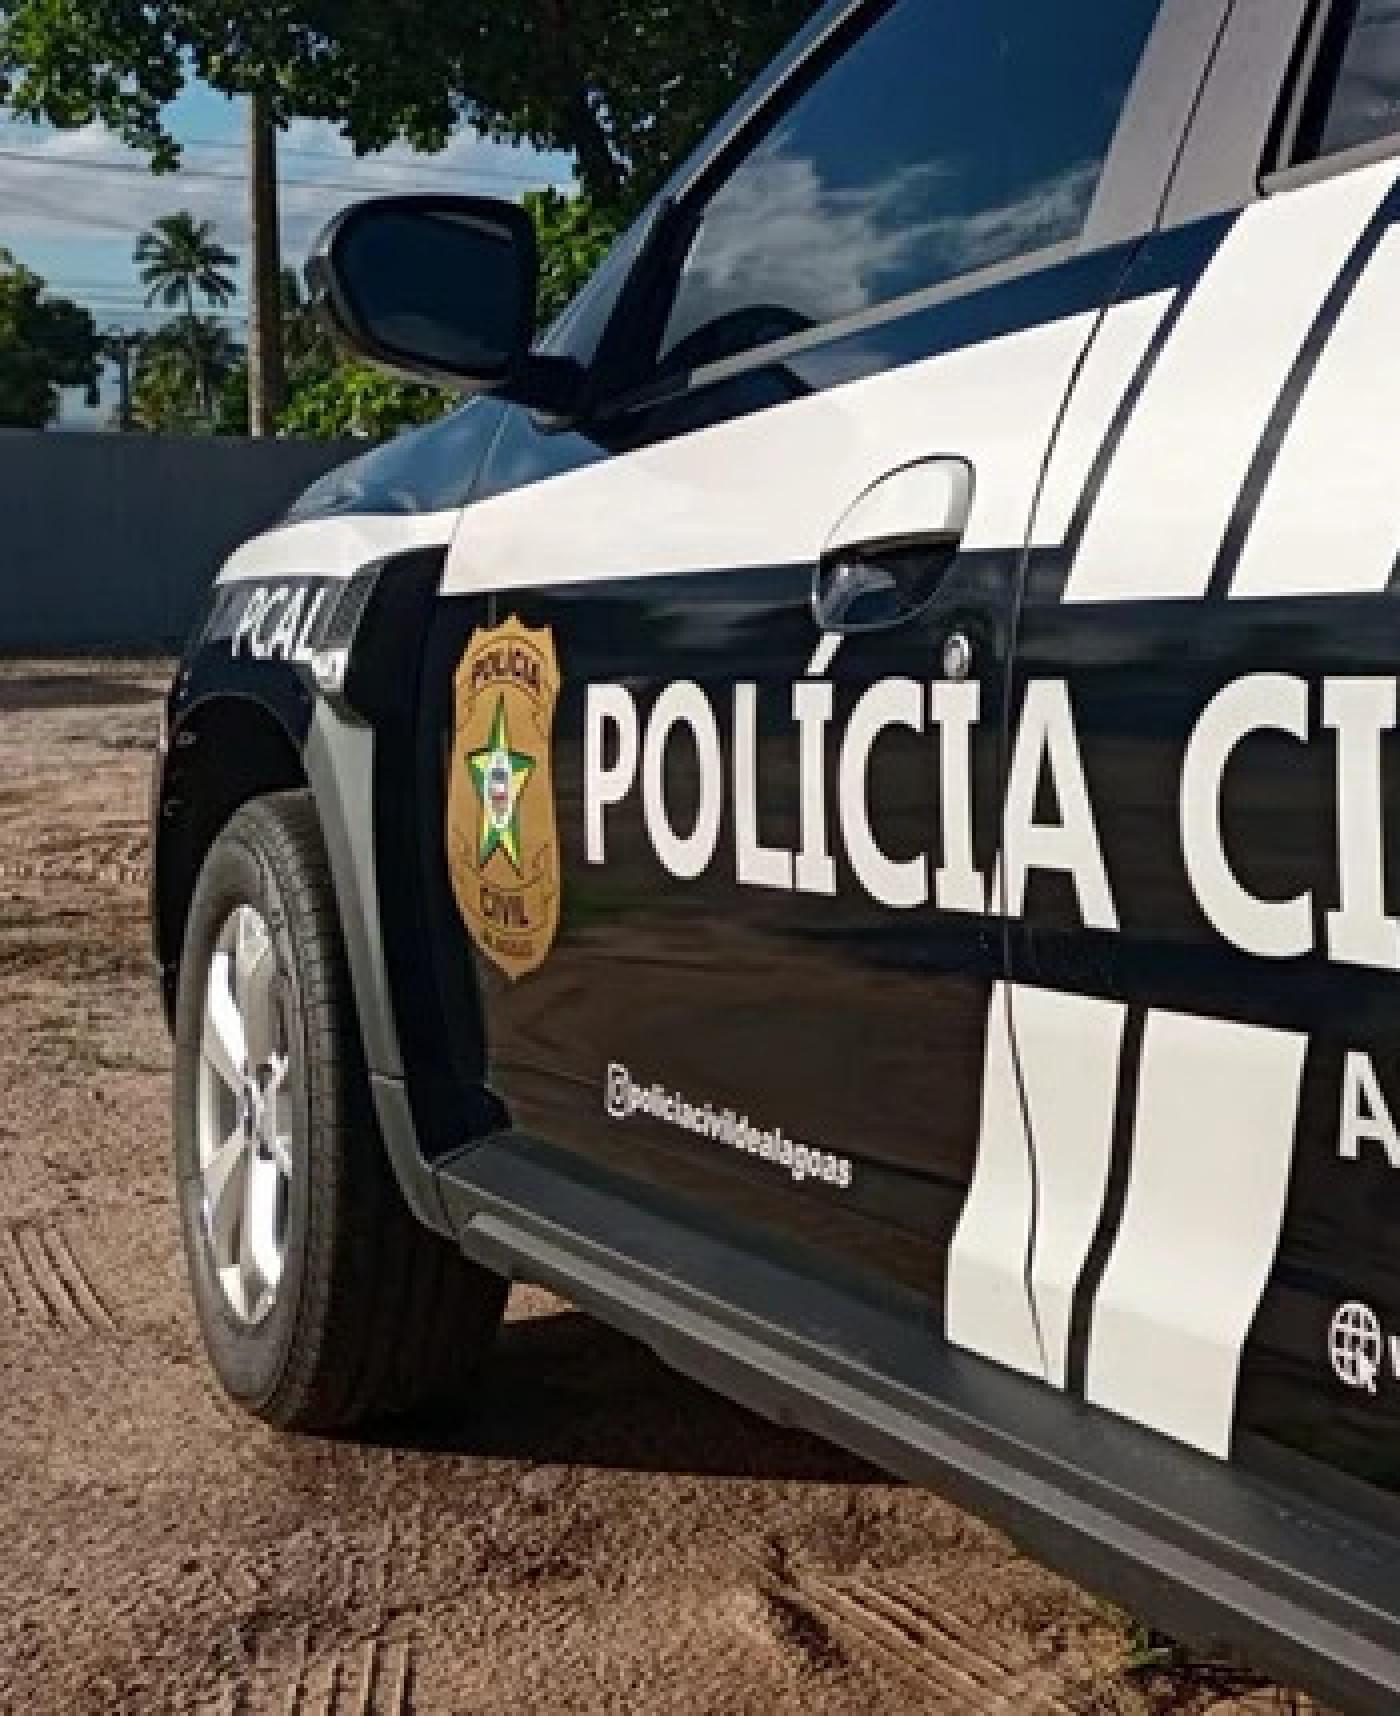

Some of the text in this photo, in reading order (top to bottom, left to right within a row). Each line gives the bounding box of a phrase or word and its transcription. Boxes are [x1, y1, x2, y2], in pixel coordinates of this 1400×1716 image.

[230, 586, 326, 661] PCAL
[584, 632, 1120, 931] POLÍCIA
[630, 1083, 852, 1188] policiacivildealagoas
